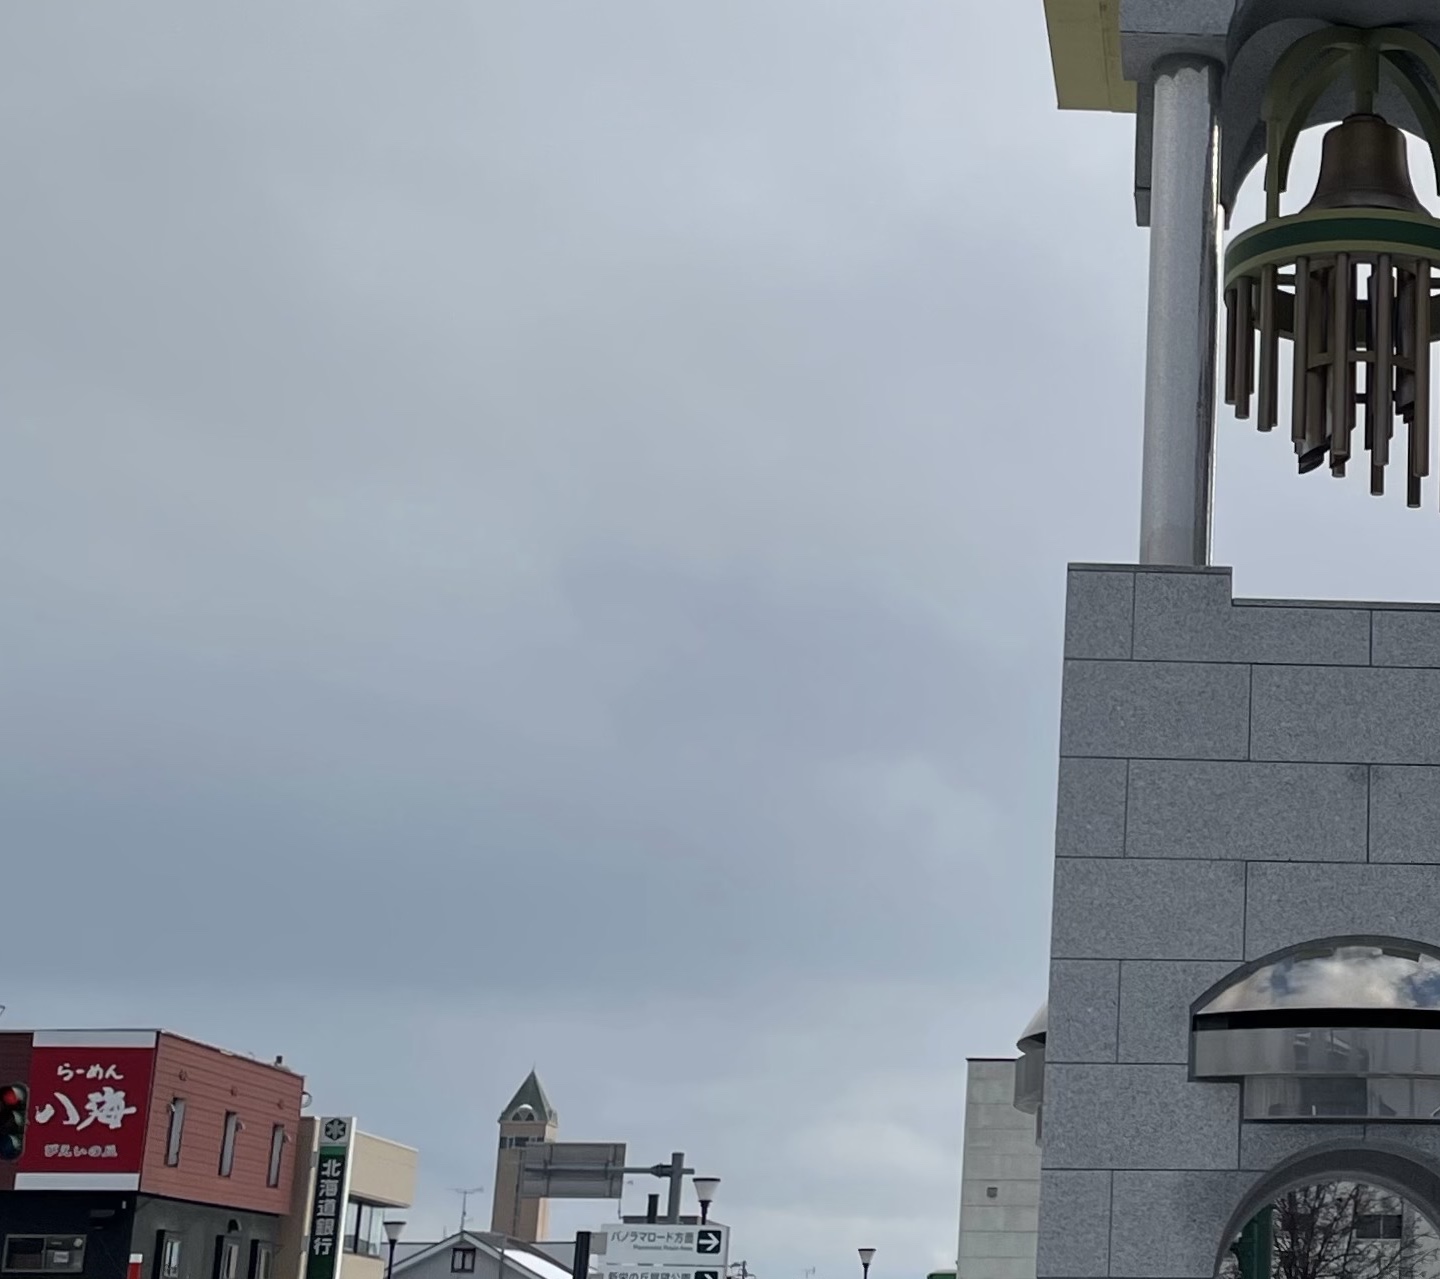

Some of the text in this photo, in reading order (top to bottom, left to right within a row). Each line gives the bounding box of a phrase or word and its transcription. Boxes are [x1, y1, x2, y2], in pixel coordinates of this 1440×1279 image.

[57, 1063, 124, 1081] らーめん
[313, 1159, 342, 1255] 北海道銀行
